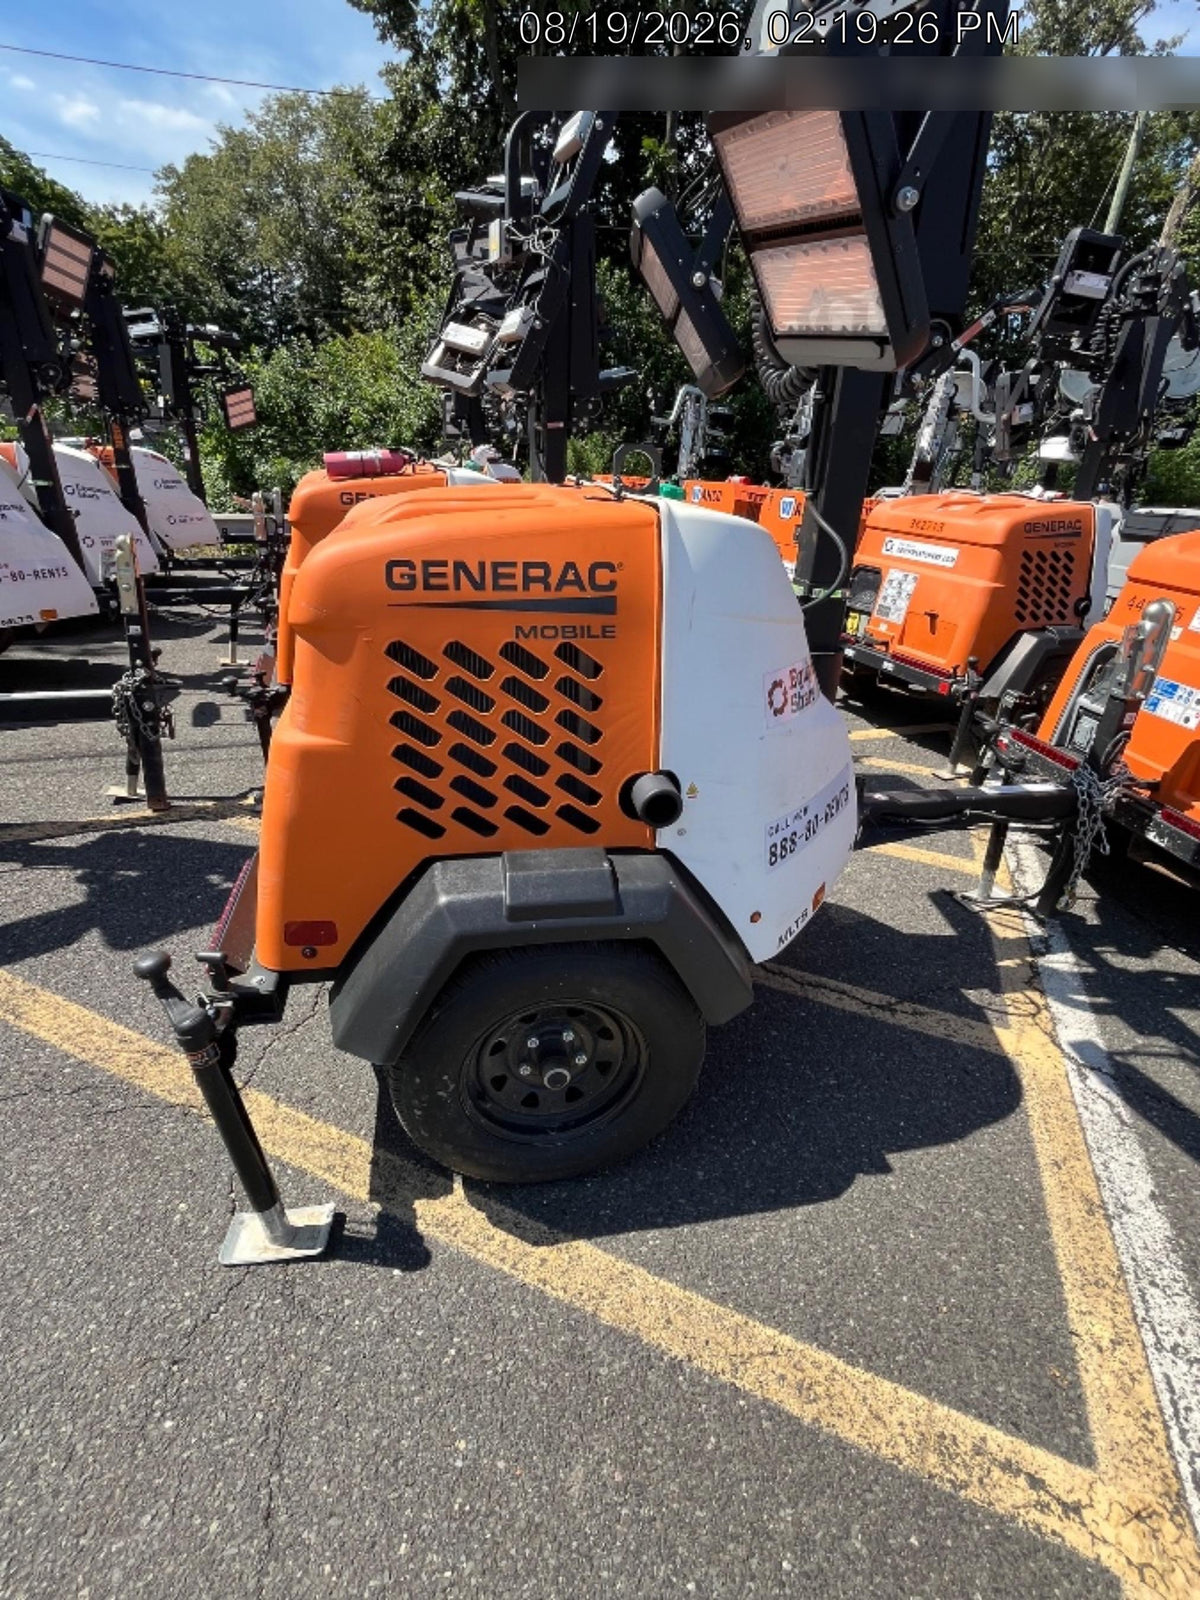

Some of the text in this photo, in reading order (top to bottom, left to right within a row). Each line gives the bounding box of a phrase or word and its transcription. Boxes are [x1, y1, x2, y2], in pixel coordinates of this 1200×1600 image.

[1023, 518, 1082, 534] GENERAC
[384, 559, 618, 593] GENERAC
[514, 624, 617, 640] MOBILE
